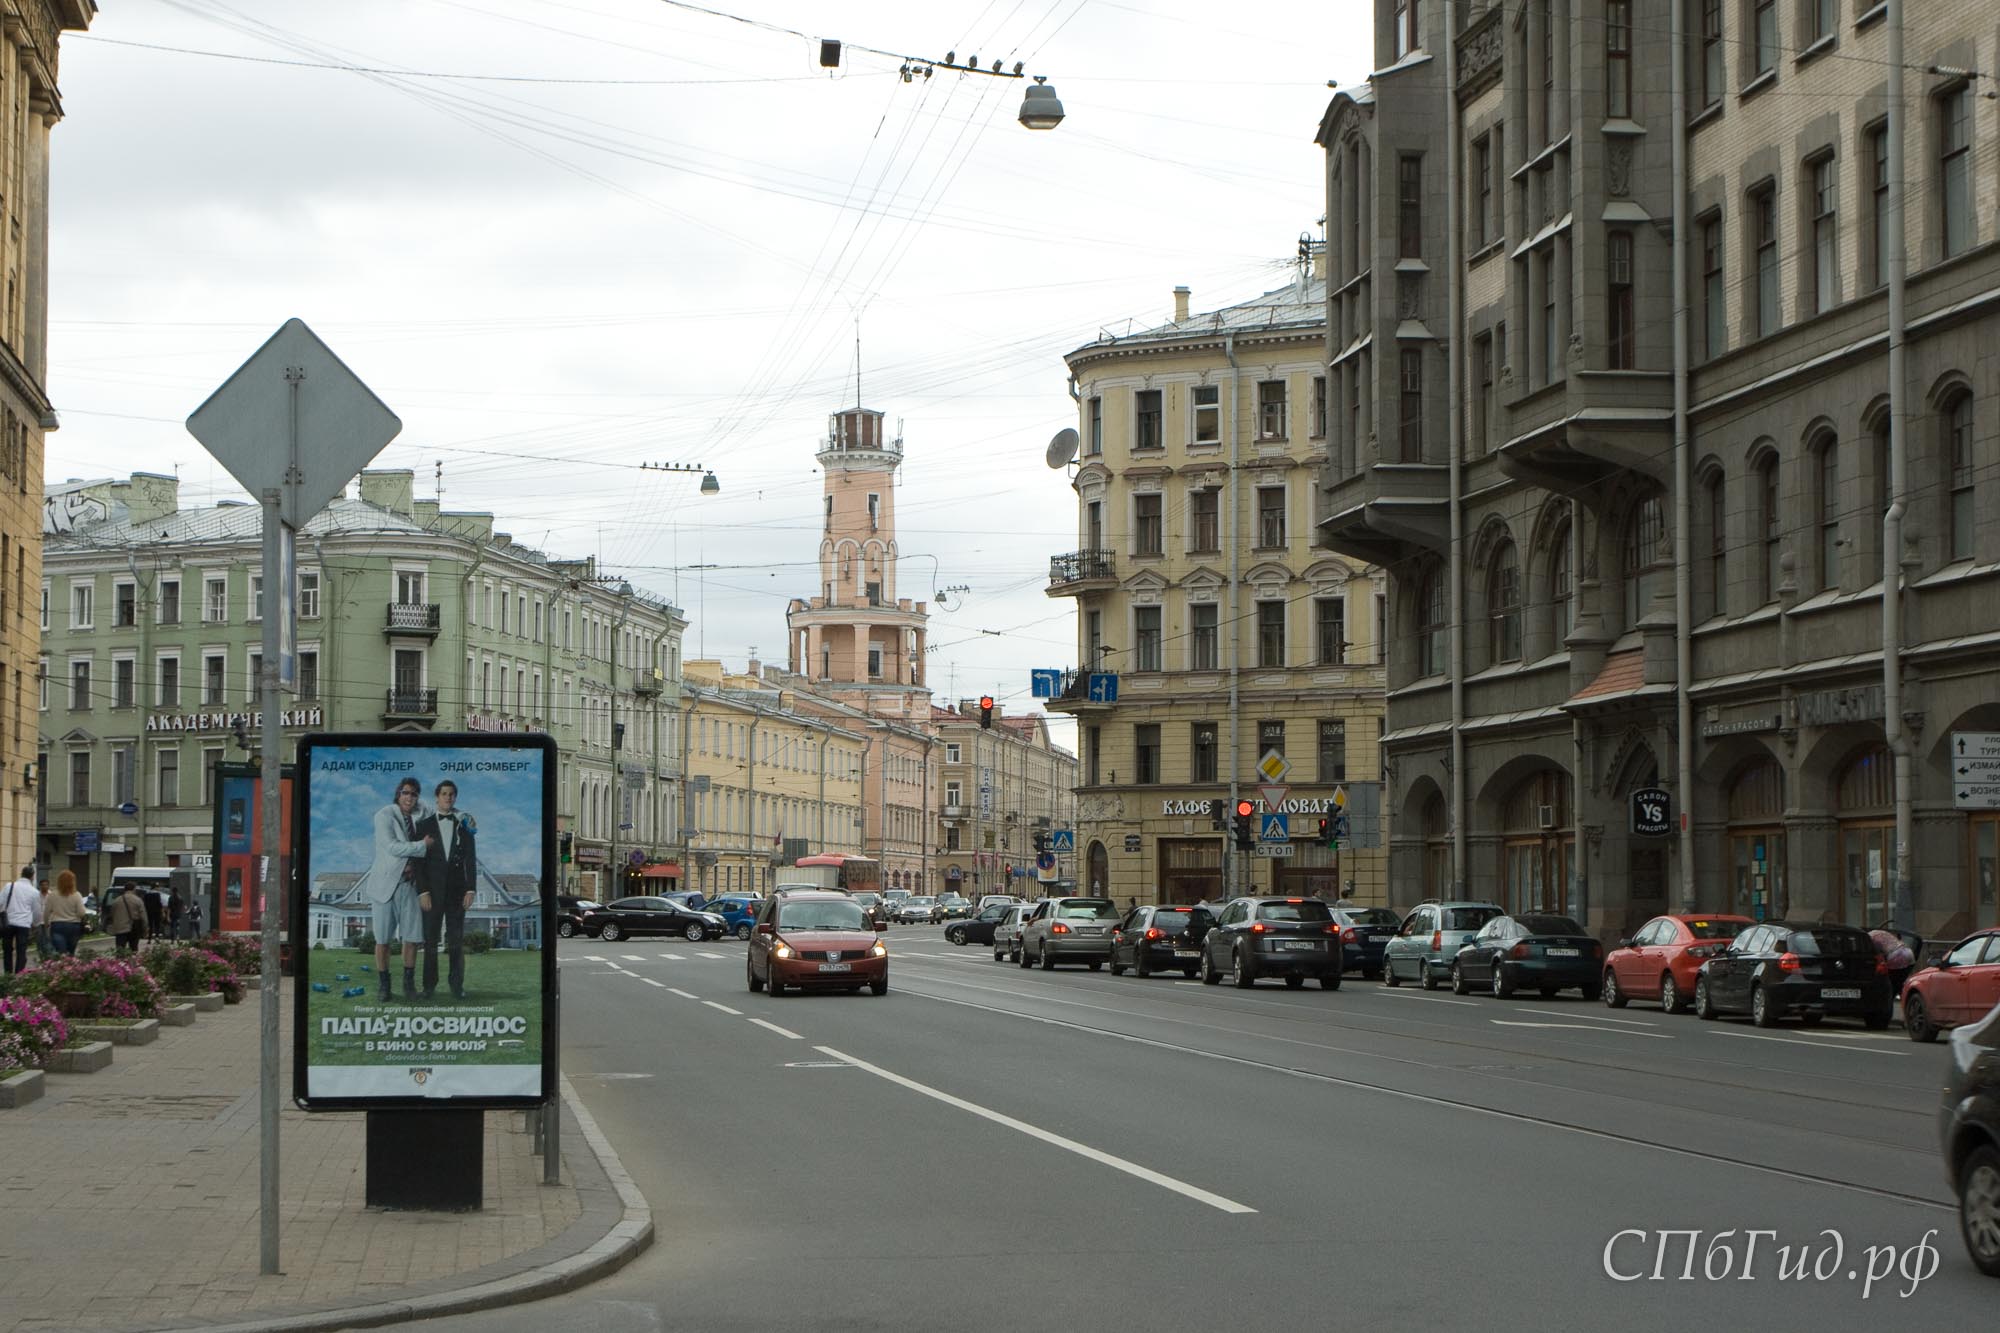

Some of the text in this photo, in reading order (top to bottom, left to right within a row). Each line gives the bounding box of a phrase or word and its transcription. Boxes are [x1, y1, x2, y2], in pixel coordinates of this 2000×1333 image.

[146, 705, 322, 732] АКАДЕМИЧЕКИЙ
[1702, 719, 1771, 736] САЛОН КРАСОТЫ
[321, 761, 531, 772] АДАМ СЭНДЛЕР ЭНДИ СЭМБЕРГ
[1637, 792, 1667, 802] САЛОН
[1162, 799, 1212, 816] КАФЕ
[1642, 803, 1663, 822] YS
[1637, 823, 1669, 832] КРАСОТЫ
[1257, 846, 1293, 856] СТОП
[384, 1006, 412, 1014] другие
[456, 1006, 495, 1014] ценности
[365, 1041, 375, 1051] В
[377, 1041, 415, 1051] КИНО
[417, 1041, 428, 1051] С
[445, 1040, 487, 1051] ИЮЛЯ
